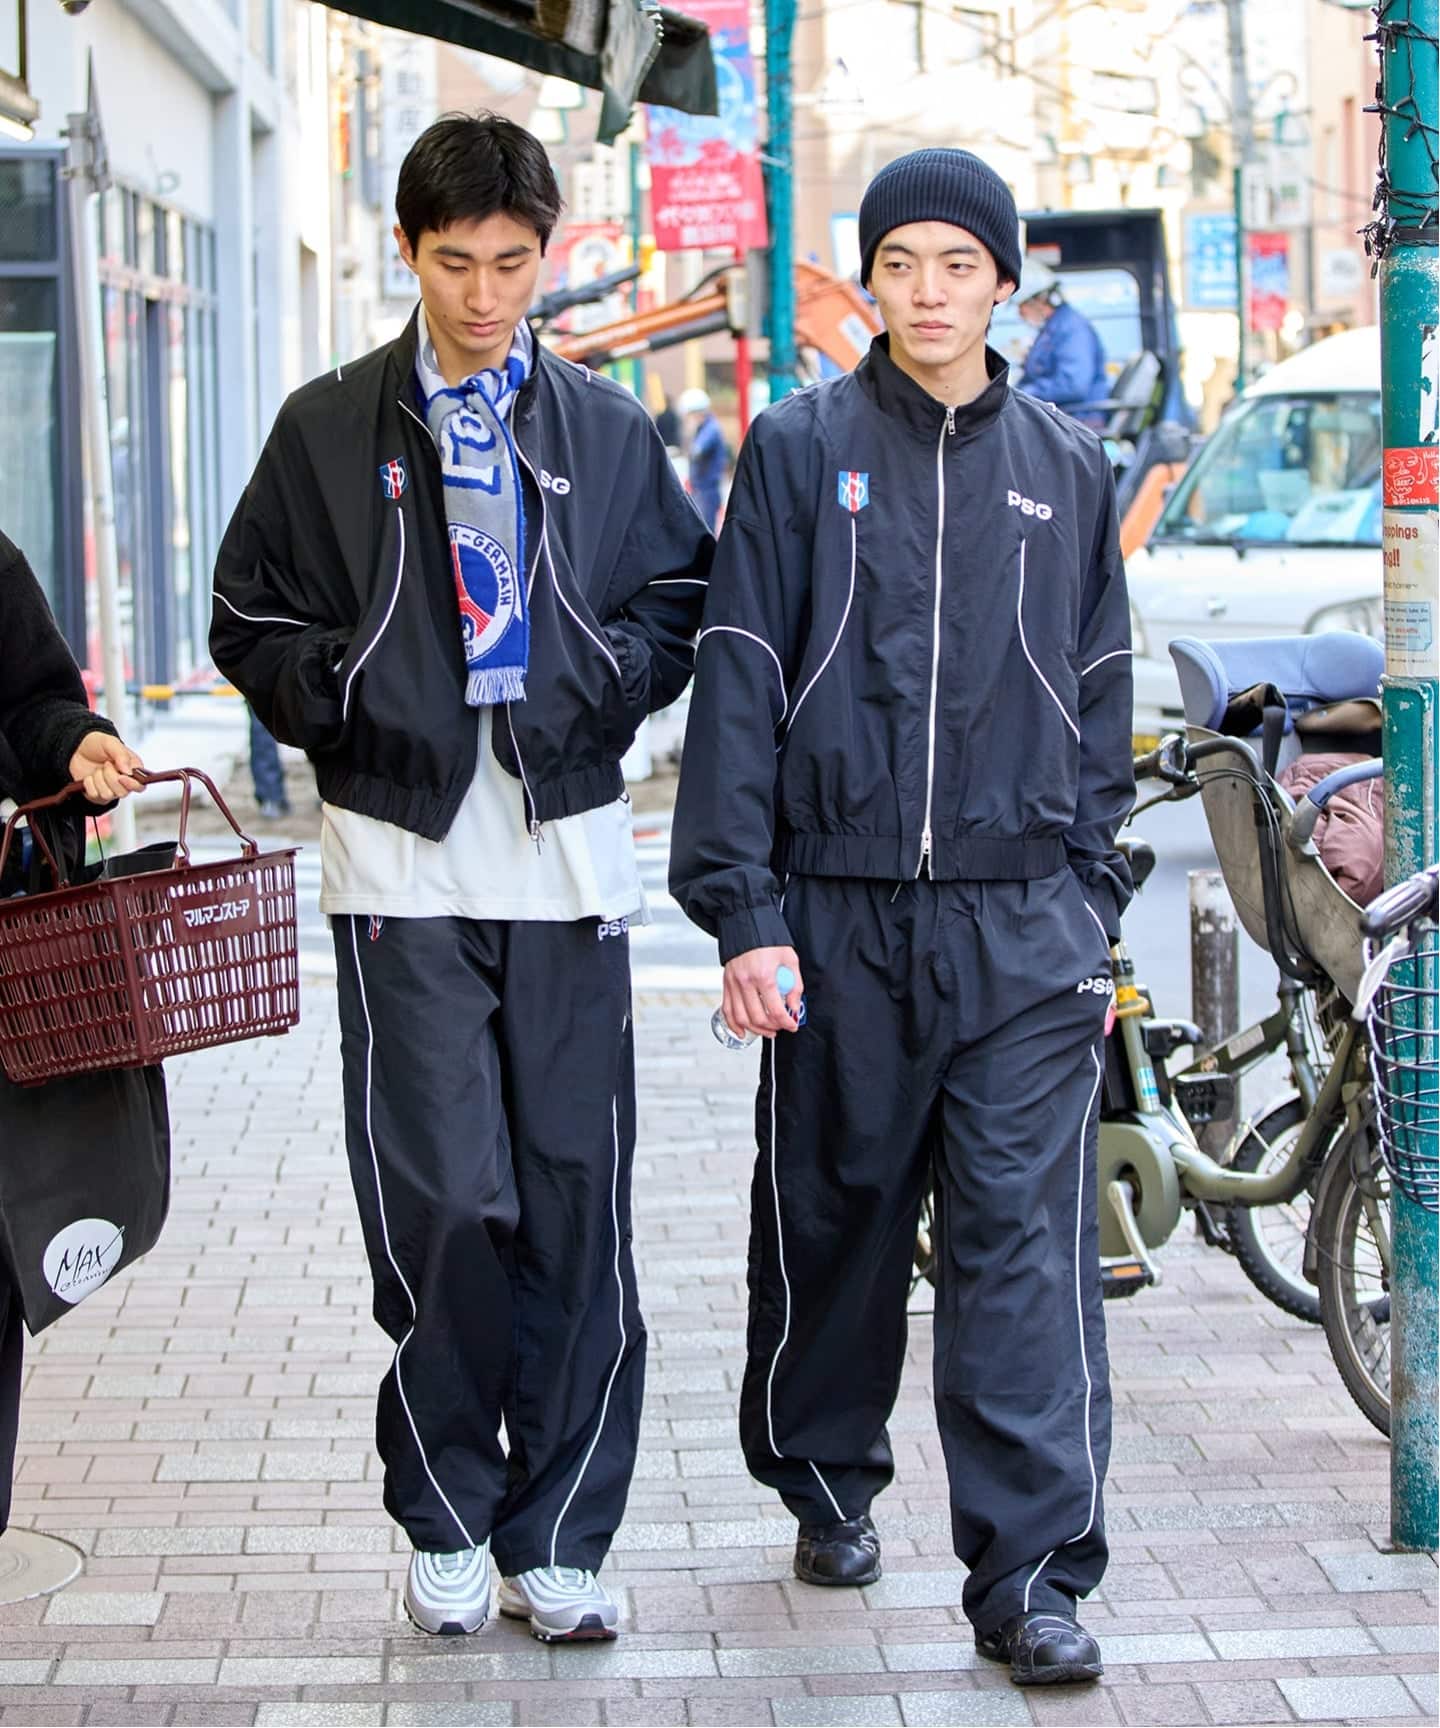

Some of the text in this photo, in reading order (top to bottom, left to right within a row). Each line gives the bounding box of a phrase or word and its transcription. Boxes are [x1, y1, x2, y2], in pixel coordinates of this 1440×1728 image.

[540, 469, 571, 495] SG
[1008, 489, 1053, 521] PSG
[183, 899, 251, 928] マルマンストア
[54, 1233, 119, 1290] MAX
